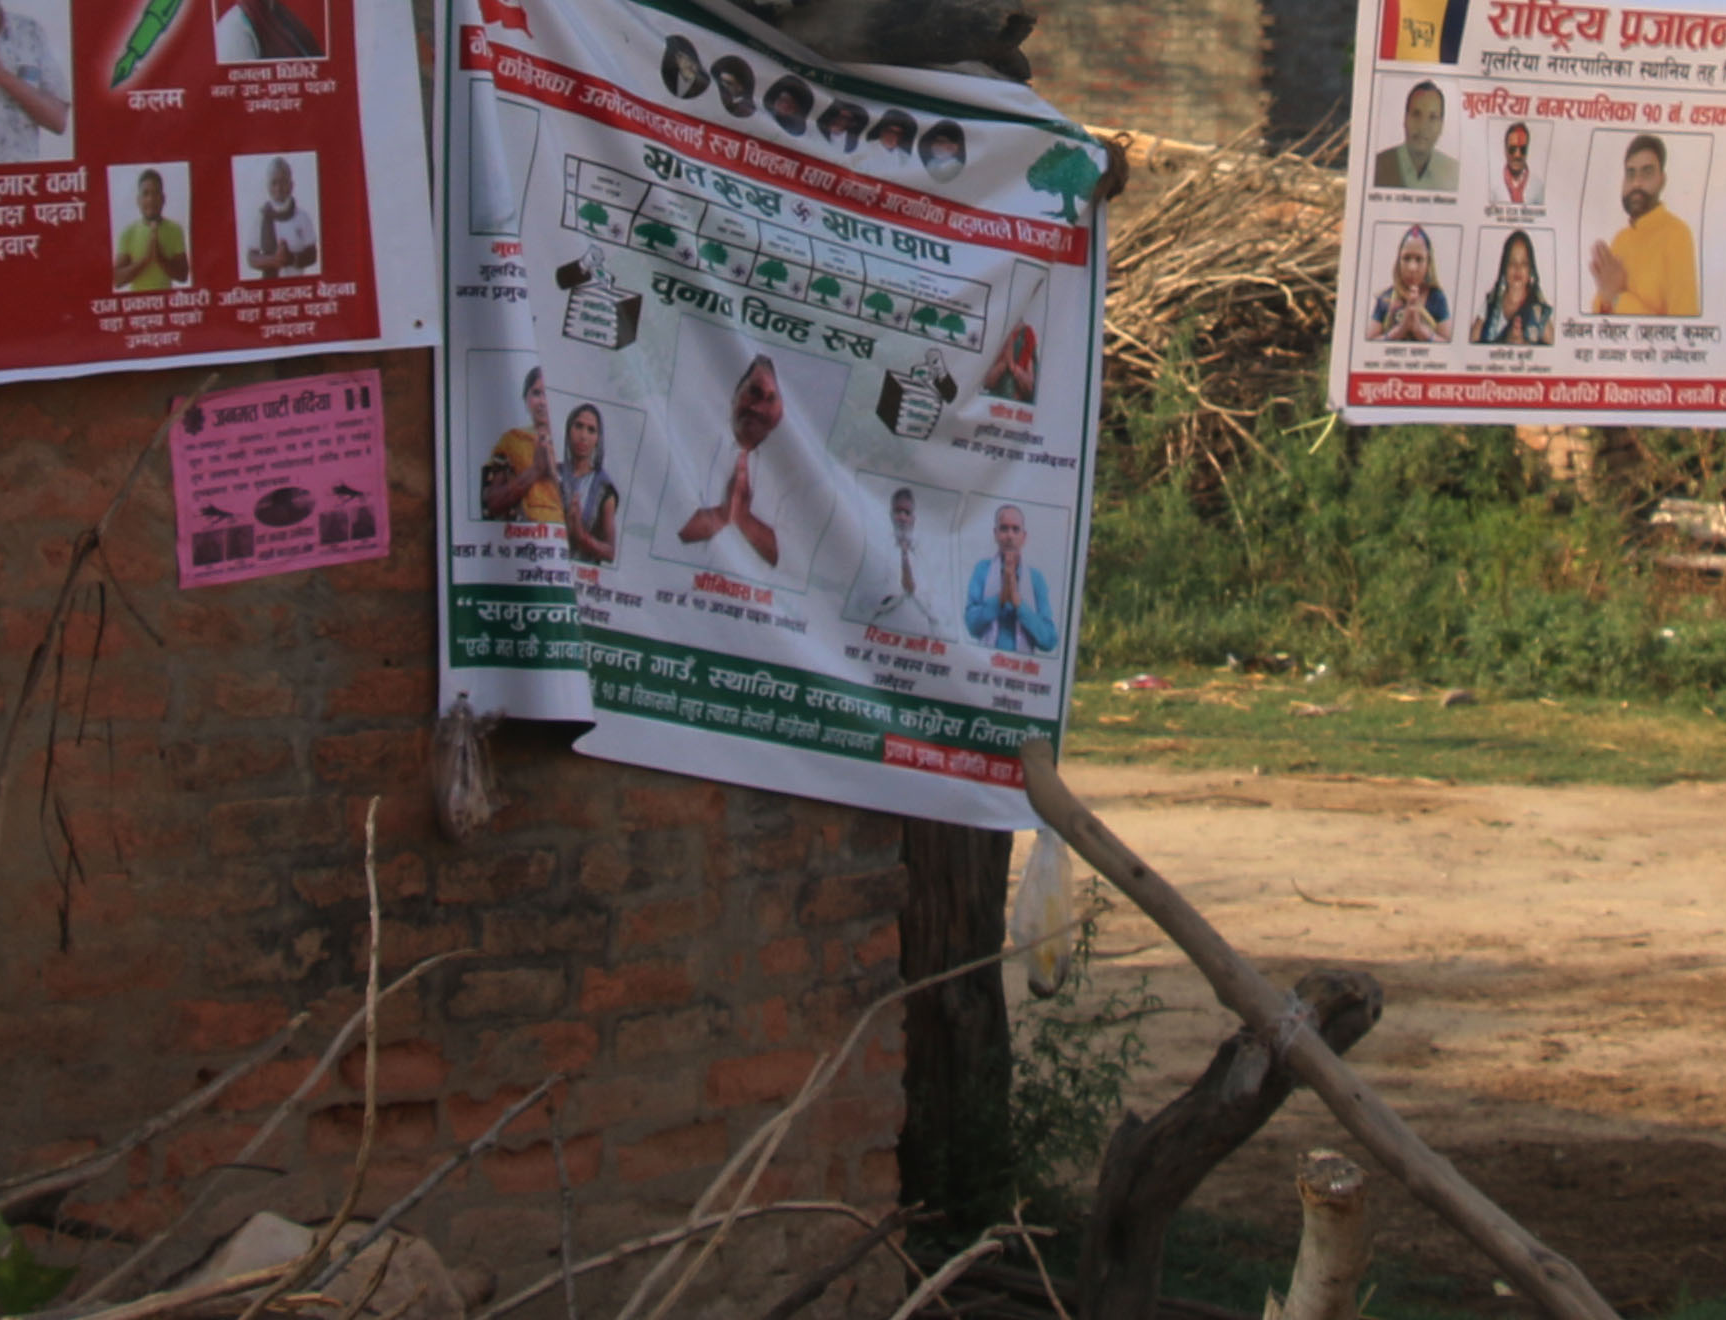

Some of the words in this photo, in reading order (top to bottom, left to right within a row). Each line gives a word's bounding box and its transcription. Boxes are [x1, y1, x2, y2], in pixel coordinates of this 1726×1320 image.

[1481, 47, 1540, 76] गुलरिया
[1547, 50, 1633, 78] नगरपालिका
[1639, 56, 1692, 80] स्थानिय
[1696, 63, 1715, 86] तह
[127, 89, 185, 112] कलम
[1463, 87, 1530, 119] गुलरिया
[1537, 91, 1637, 123] नगरपालिका
[1642, 104, 1662, 123] १०
[45, 167, 88, 194] वर्मा
[802, 164, 837, 190] छाप
[34, 197, 86, 223] पदको
[892, 223, 952, 264] छाप
[742, 291, 815, 345] चिन्ह
[1358, 378, 1423, 405] गुलरिया
[1428, 379, 1545, 403] नगरपालिकाको
[263, 395, 289, 418] पार्टी
[804, 685, 892, 723] सरकारमा
